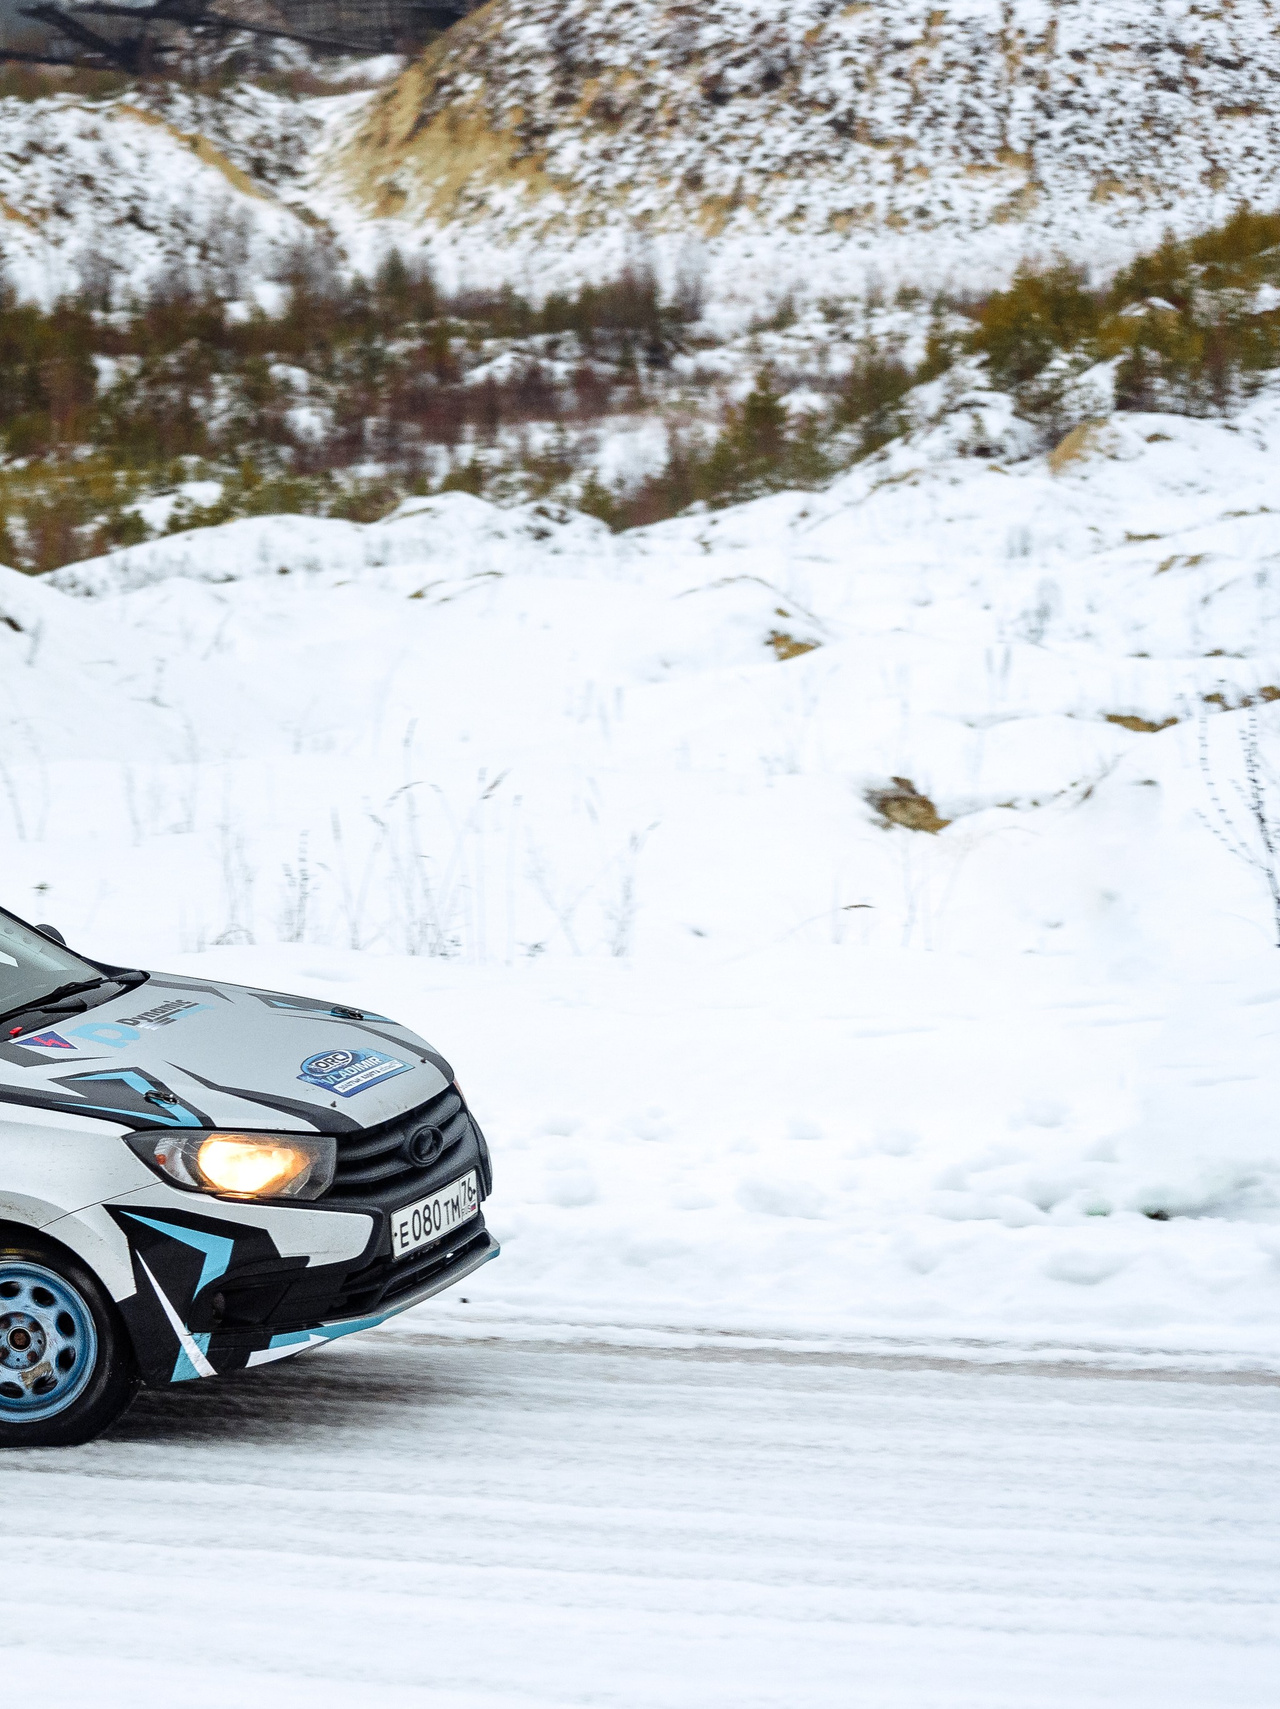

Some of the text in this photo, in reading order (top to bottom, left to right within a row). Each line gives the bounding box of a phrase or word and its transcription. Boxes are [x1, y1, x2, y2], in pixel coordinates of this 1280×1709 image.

[115, 999, 192, 1027] Dynamic
[314, 1052, 350, 1069] ORC
[322, 1056, 381, 1085] VLADIMIR
